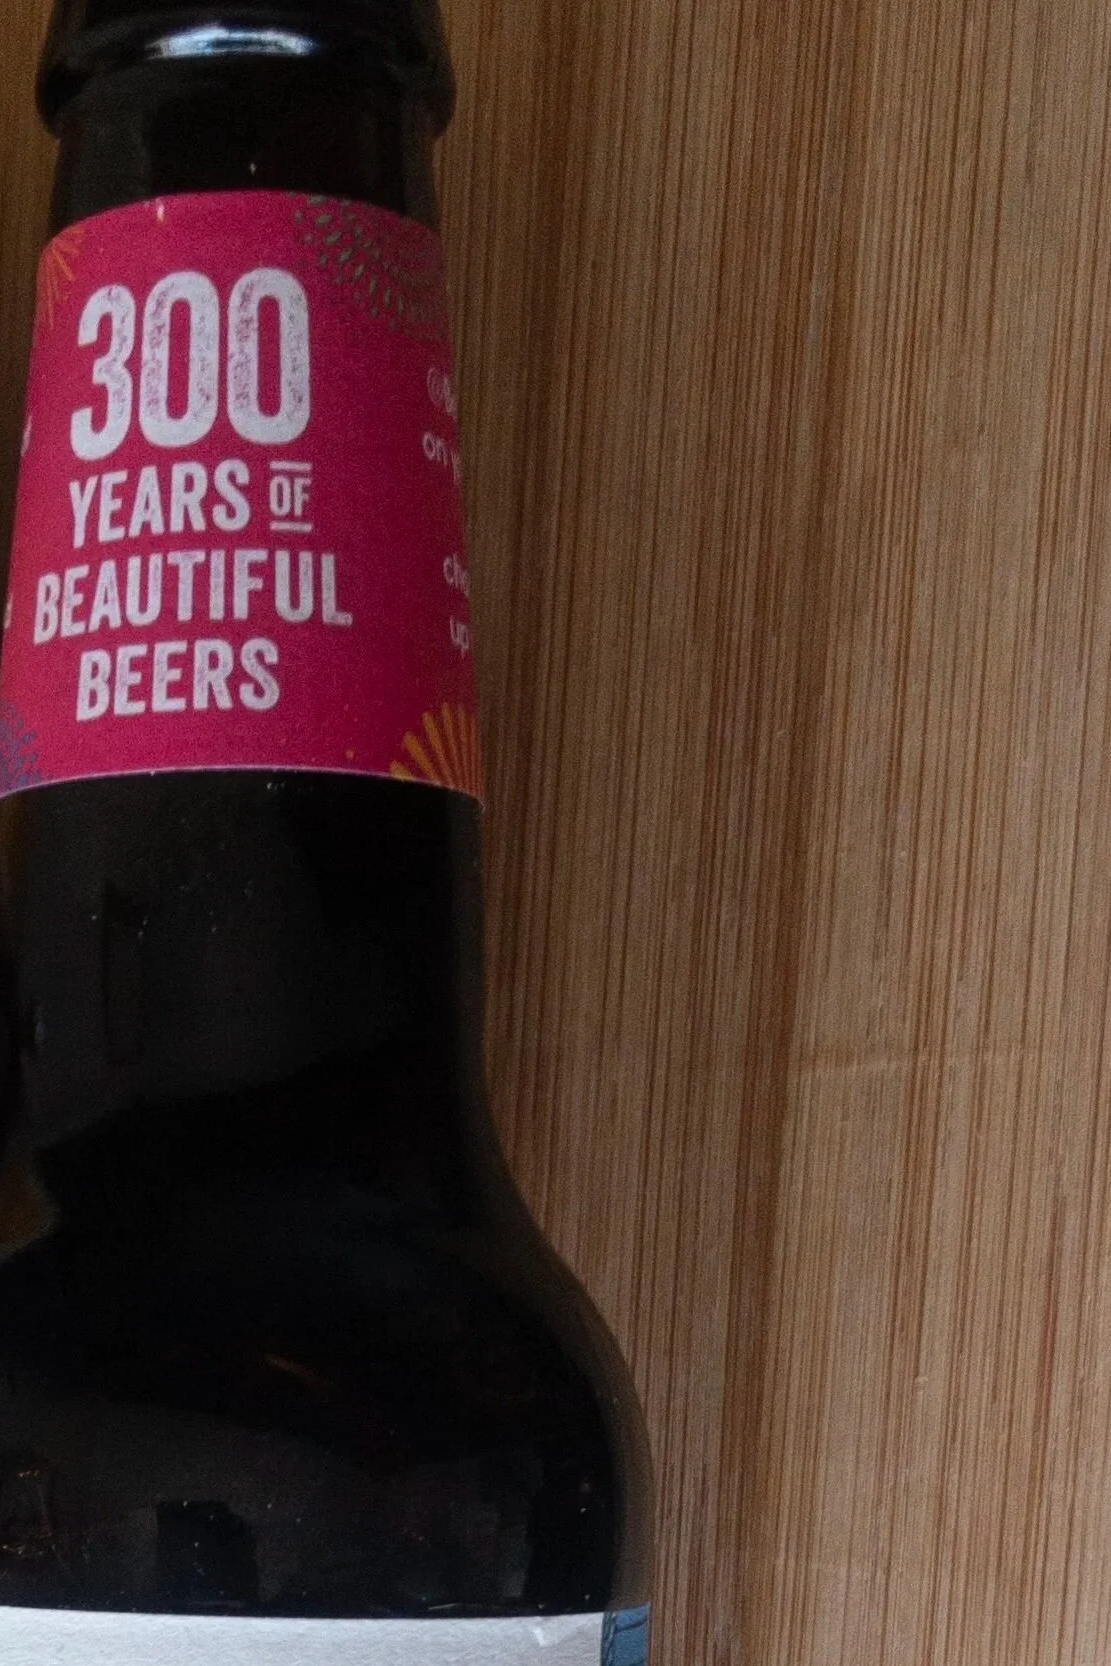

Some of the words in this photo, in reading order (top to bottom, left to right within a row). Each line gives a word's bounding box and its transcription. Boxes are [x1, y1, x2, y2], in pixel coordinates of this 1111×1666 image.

[69, 267, 311, 461] 300
[68, 459, 251, 550] YEARS
[269, 475, 312, 517] OF
[32, 549, 353, 646] BEAUTIFUL
[76, 637, 281, 722] BEERS
